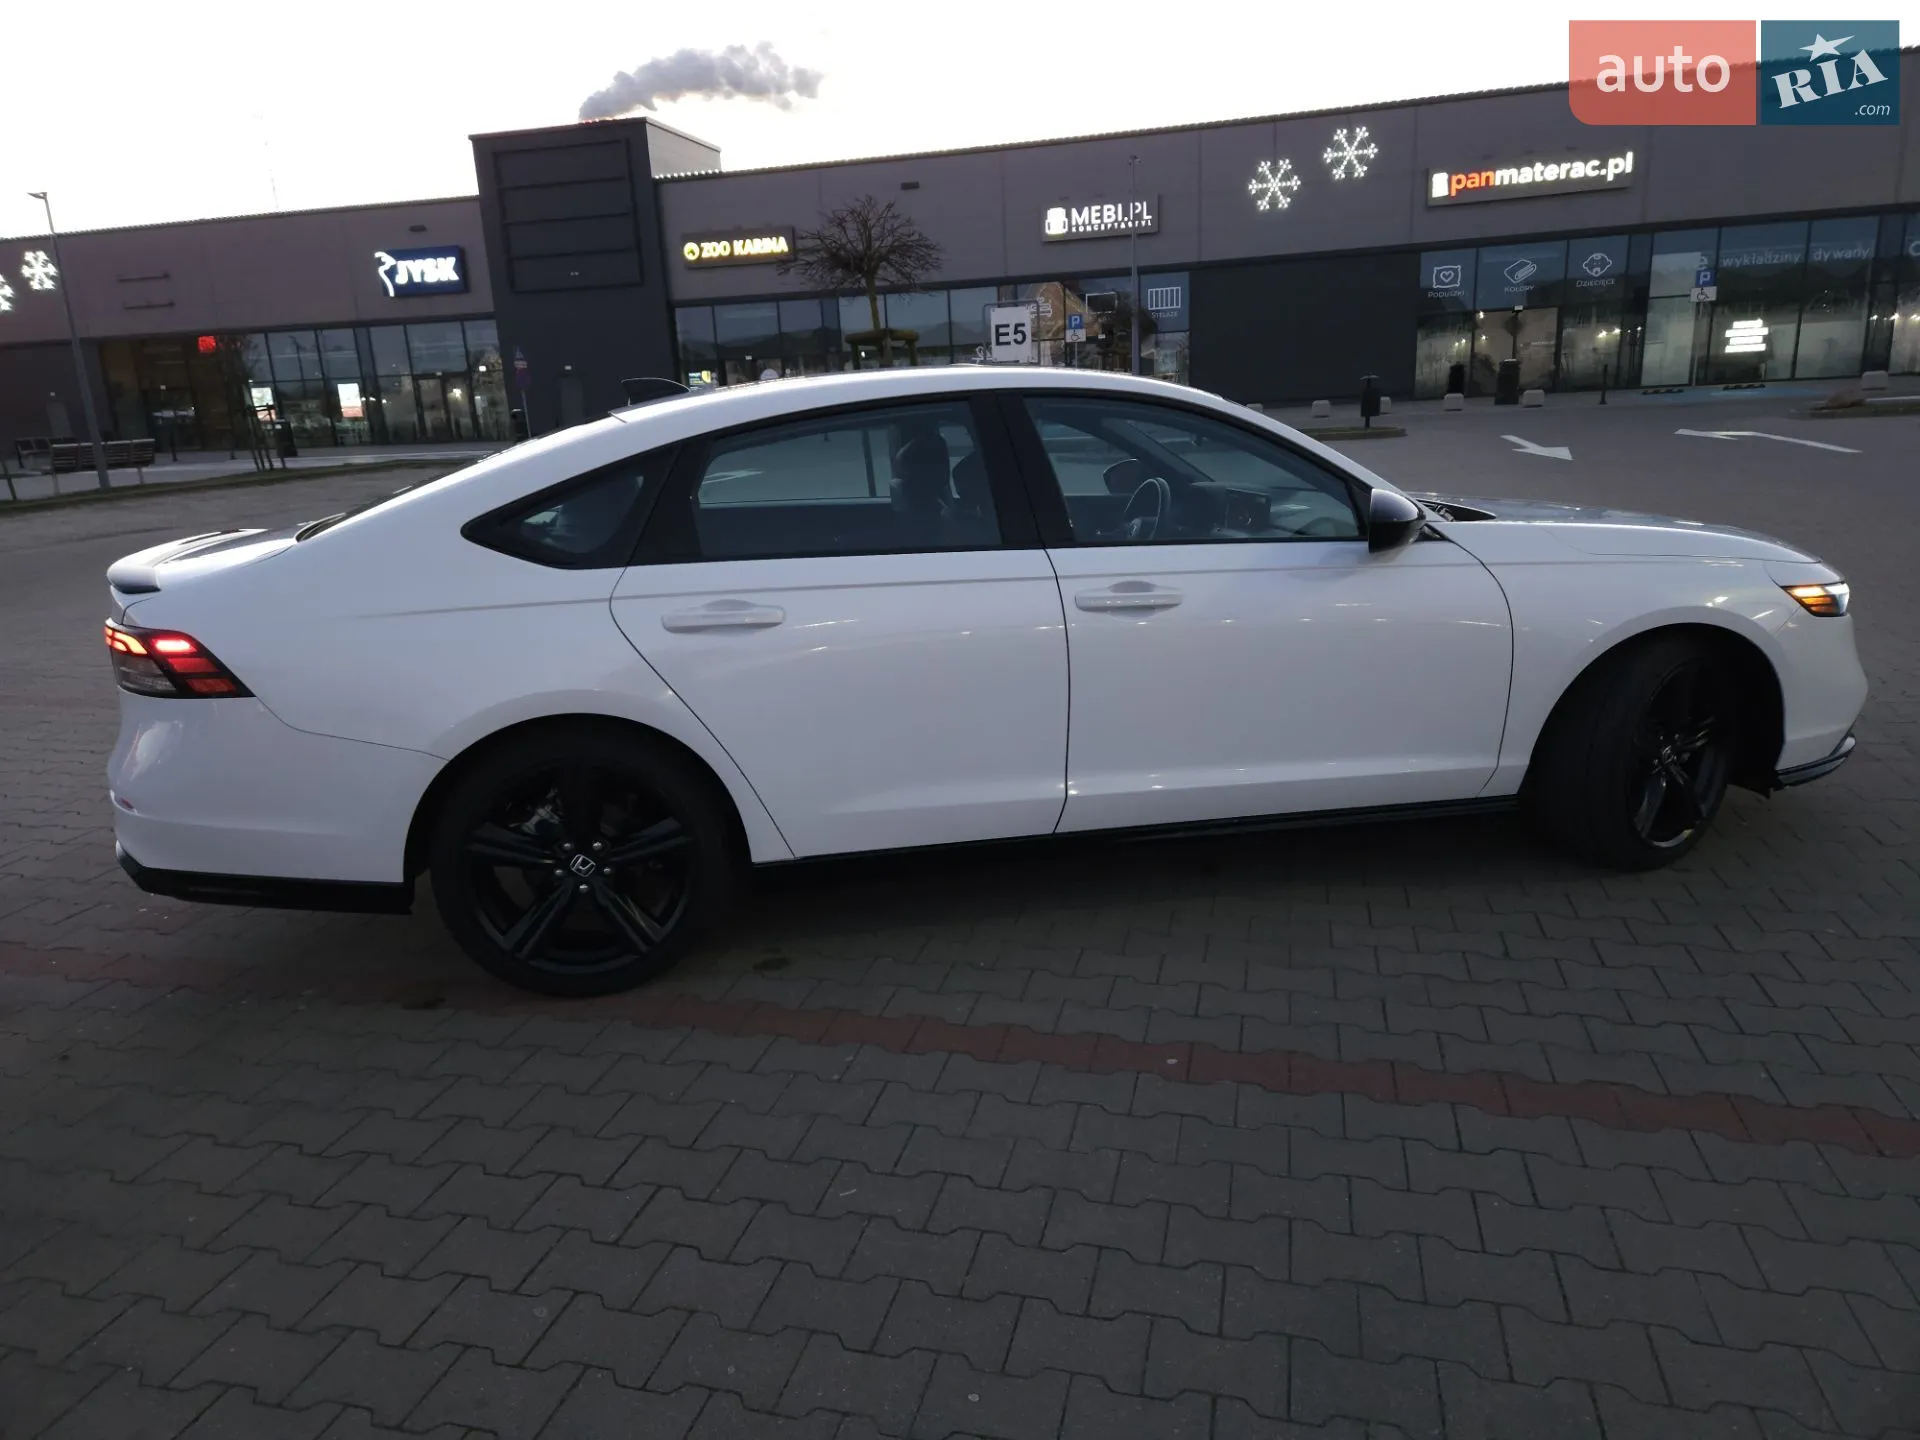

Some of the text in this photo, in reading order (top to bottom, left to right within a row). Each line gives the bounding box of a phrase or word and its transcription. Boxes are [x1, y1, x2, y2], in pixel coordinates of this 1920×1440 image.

[1450, 151, 1634, 197] panmaterac.pl
[1071, 201, 1152, 226] MEBI.PL
[700, 240, 731, 258] ZOO
[1813, 247, 1870, 263] dywany
[395, 256, 459, 284] JYSK
[1700, 271, 1710, 284] P
[1071, 315, 1080, 328] P
[994, 322, 1027, 346] E5
